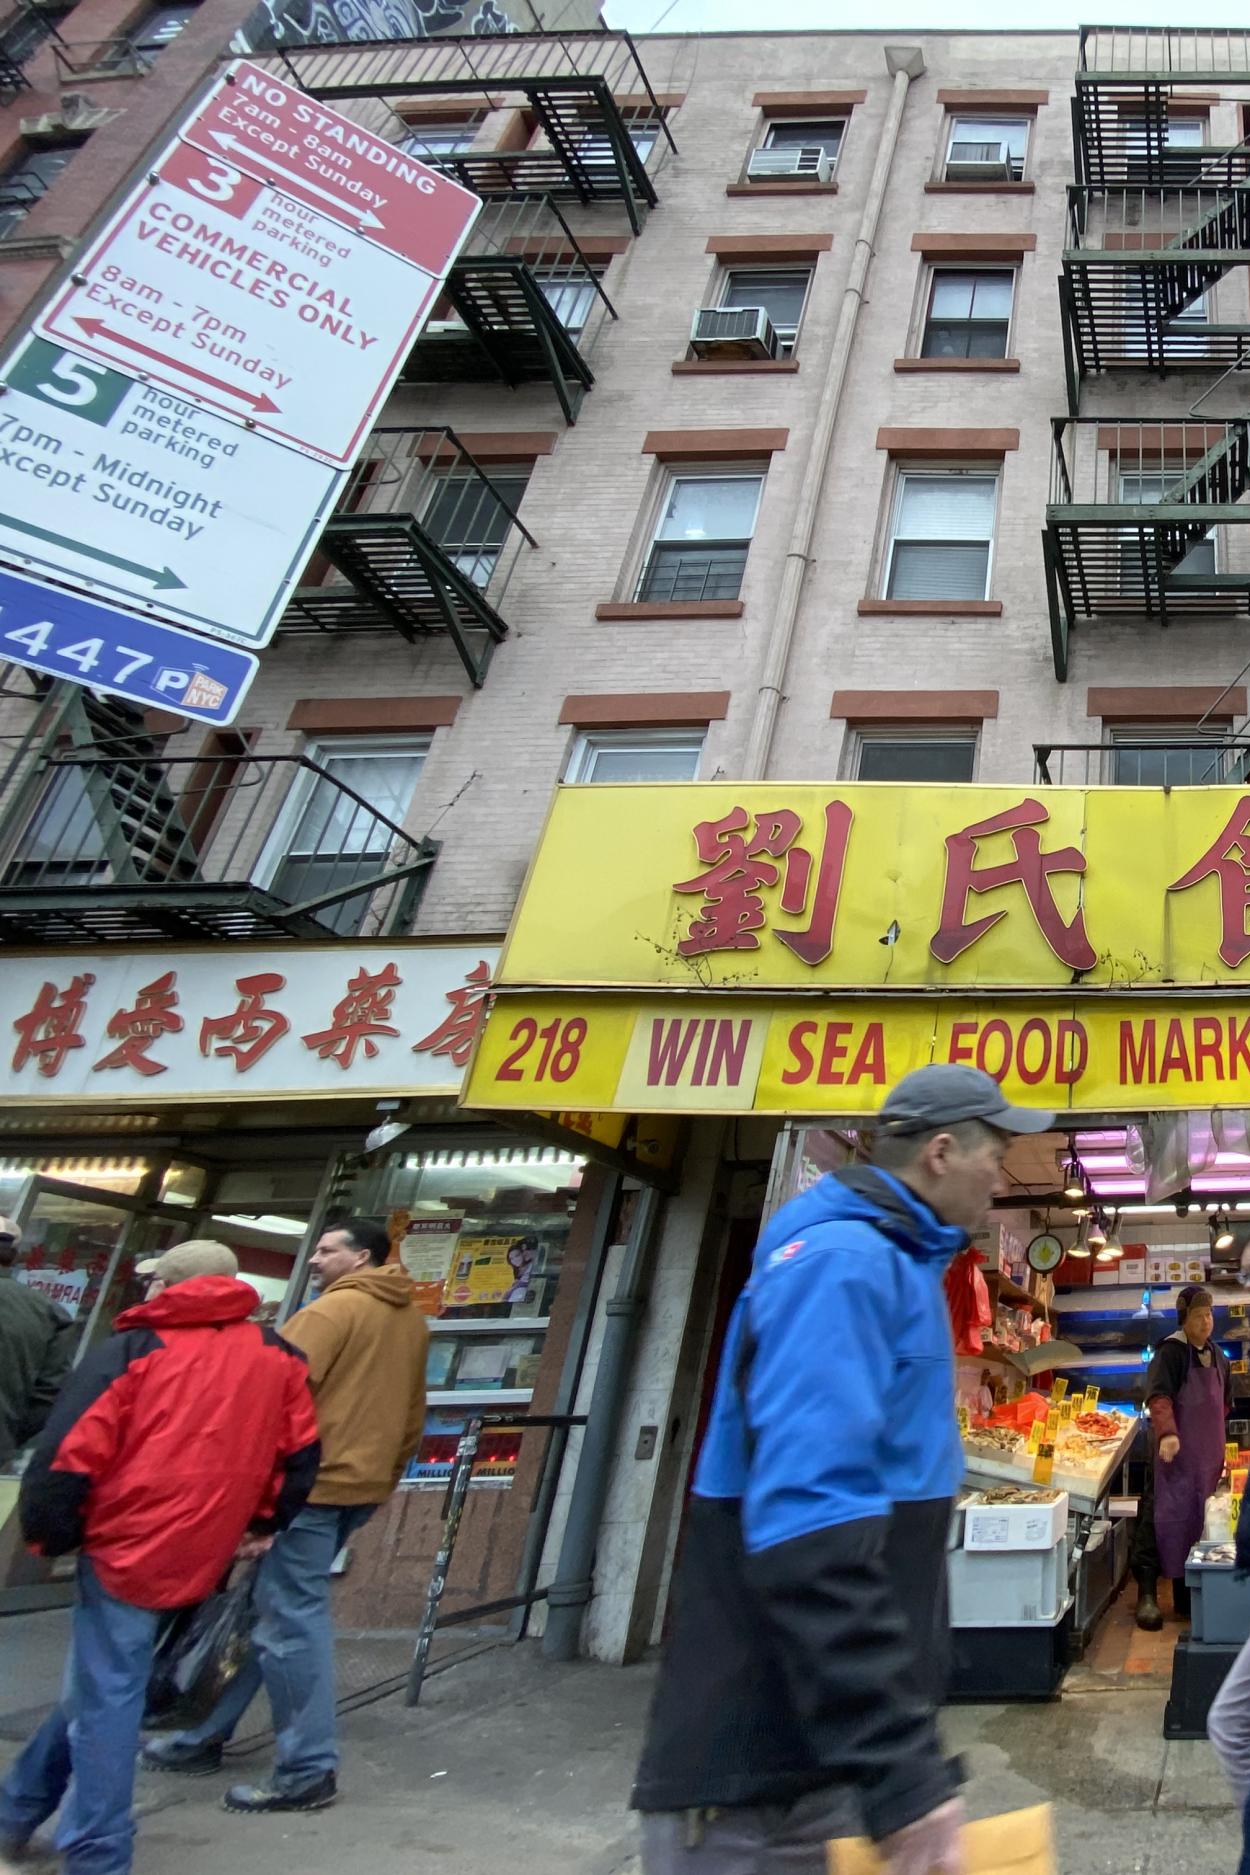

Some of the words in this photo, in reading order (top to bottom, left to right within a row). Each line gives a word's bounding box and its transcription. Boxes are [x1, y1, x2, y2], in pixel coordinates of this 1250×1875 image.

[217, 106, 300, 160] Except
[304, 155, 388, 209] Sunday
[232, 92, 281, 129] 7am
[303, 134, 353, 170] 8am
[241, 74, 287, 107] NO
[292, 104, 437, 195] STANDING
[187, 157, 243, 203] 3
[269, 193, 320, 224] hour
[148, 202, 353, 318] COMMERCIAL
[252, 220, 333, 269] parking
[261, 206, 352, 259] metered
[100, 265, 163, 304] 8am
[189, 305, 248, 345] 7pm
[137, 220, 291, 310] VEHICLES
[297, 303, 380, 352] ONLY
[85, 282, 187, 340] Except
[190, 332, 293, 390] Sunday
[36, 354, 108, 407] 5
[141, 388, 201, 420] hour
[0, 412, 63, 455] 7pm
[92, 453, 223, 519] Midnight
[121, 420, 216, 470] parking
[131, 404, 240, 457] metered
[0, 446, 87, 494] xcept
[92, 482, 205, 541] Sunday
[0, 612, 155, 684] 447
[154, 670, 189, 692] P
[186, 688, 221, 708] NYC
[194, 674, 225, 696] PARK
[13, 960, 497, 1077] 博愛西藥房
[495, 1016, 588, 1083] 218
[645, 1018, 753, 1087] WIN
[781, 1021, 886, 1086] SEA
[948, 1018, 1089, 1085] FOOD
